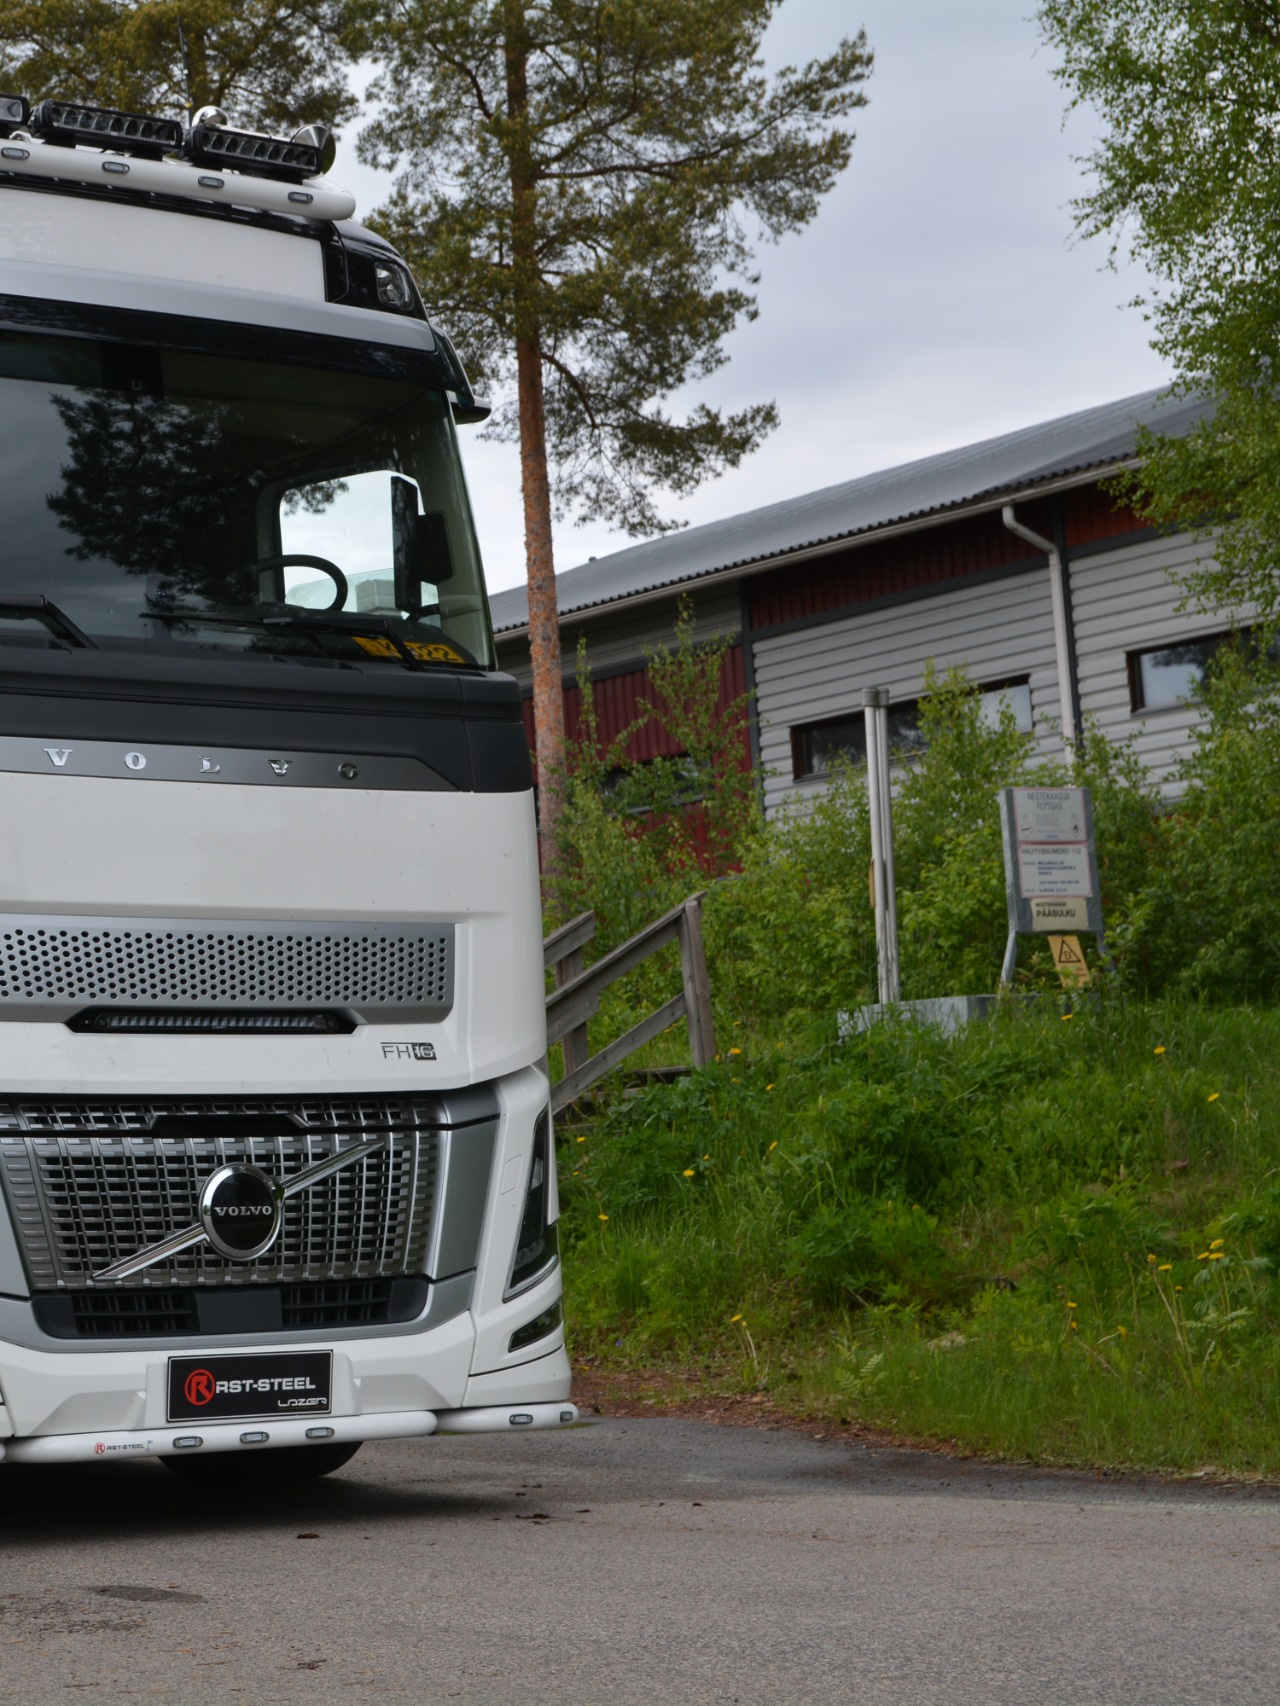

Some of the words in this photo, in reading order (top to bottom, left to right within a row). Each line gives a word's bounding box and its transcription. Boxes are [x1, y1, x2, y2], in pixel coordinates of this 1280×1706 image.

[43, 748, 358, 780] VOLVO
[1072, 847, 1082, 855] 112
[214, 1205, 272, 1216] VOLVO
[216, 1377, 316, 1394] RST-STEEL
[107, 1443, 145, 1451] RST-STEEL
